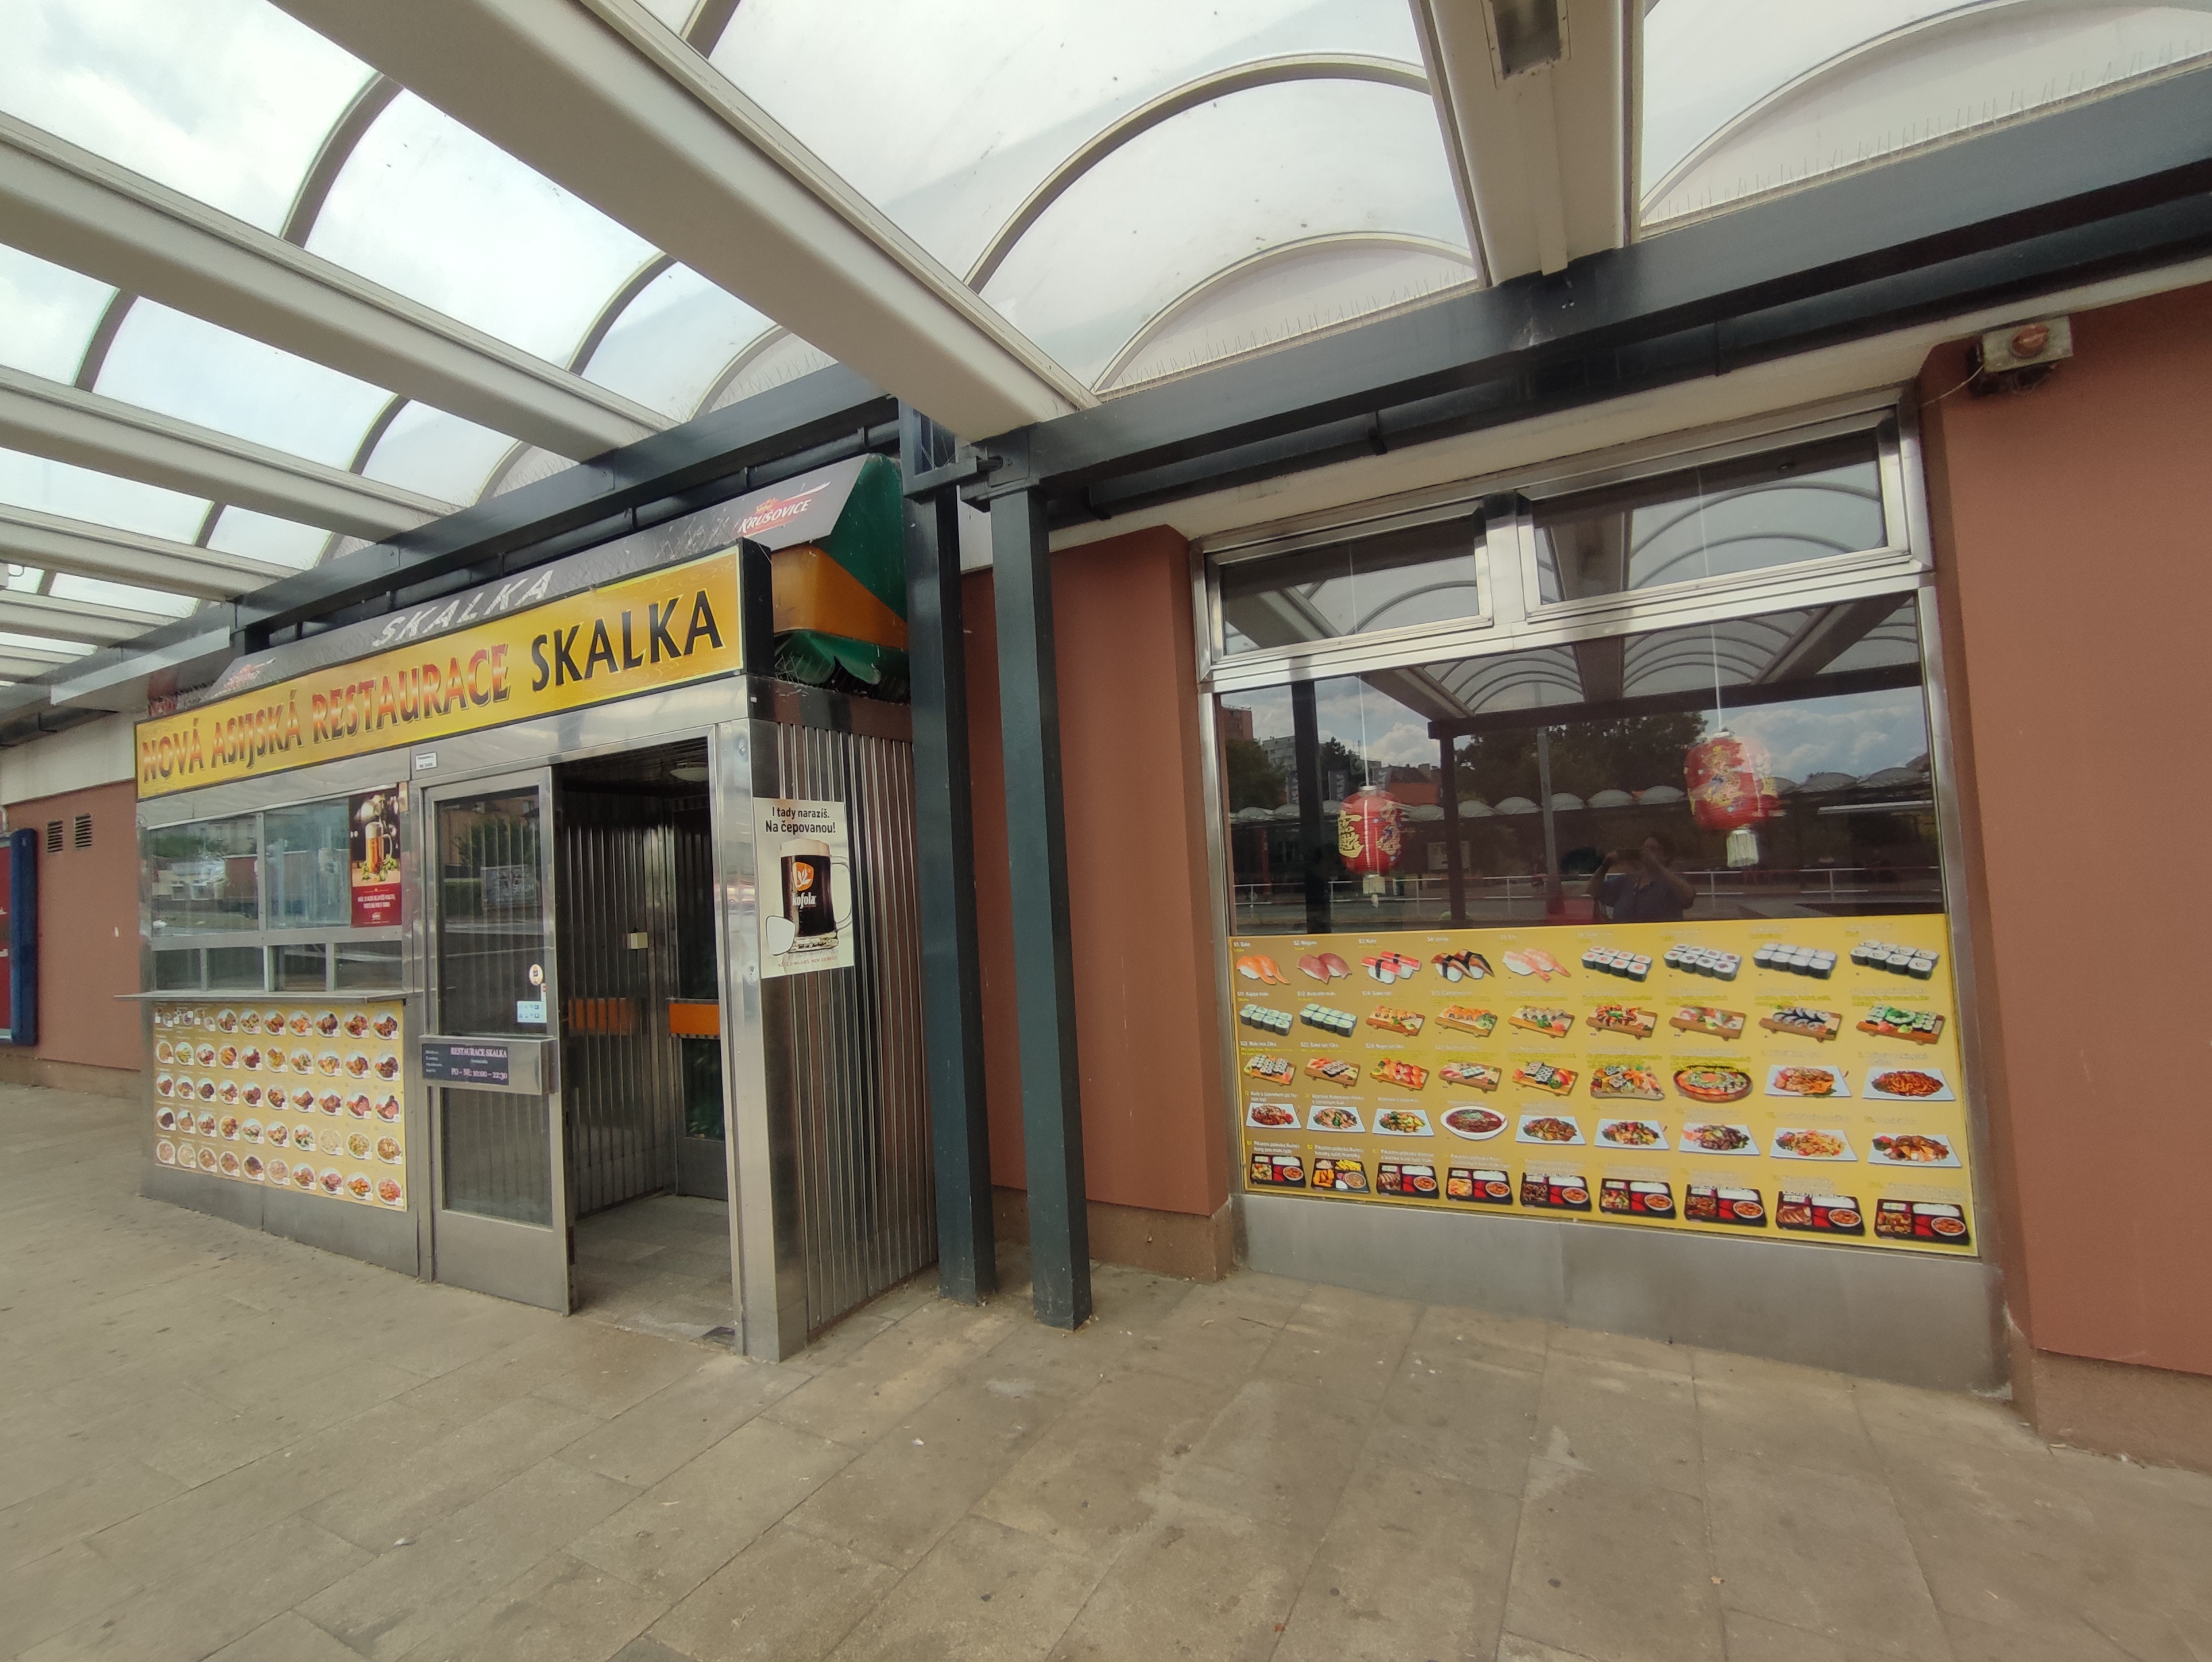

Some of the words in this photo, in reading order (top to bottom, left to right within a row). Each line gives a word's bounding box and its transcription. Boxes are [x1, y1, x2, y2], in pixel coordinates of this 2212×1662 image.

[738, 498, 812, 534] KRUŠOVICE
[372, 570, 554, 647] SKALKA
[142, 718, 205, 783] NOVÁ
[211, 689, 303, 770] ASIJSKÁ
[312, 643, 510, 744] RESTAURACE
[531, 588, 726, 693] SKALKA
[772, 807, 775, 816] I
[777, 807, 796, 820] tady
[798, 808, 830, 819] narazíš.
[765, 820, 778, 832] Na
[781, 820, 836, 835] čepovanou!
[792, 892, 816, 909] kofola
[450, 1047, 485, 1057] RESTAURACE
[486, 1048, 507, 1058] SKALKA
[492, 1071, 507, 1081] 22:30
